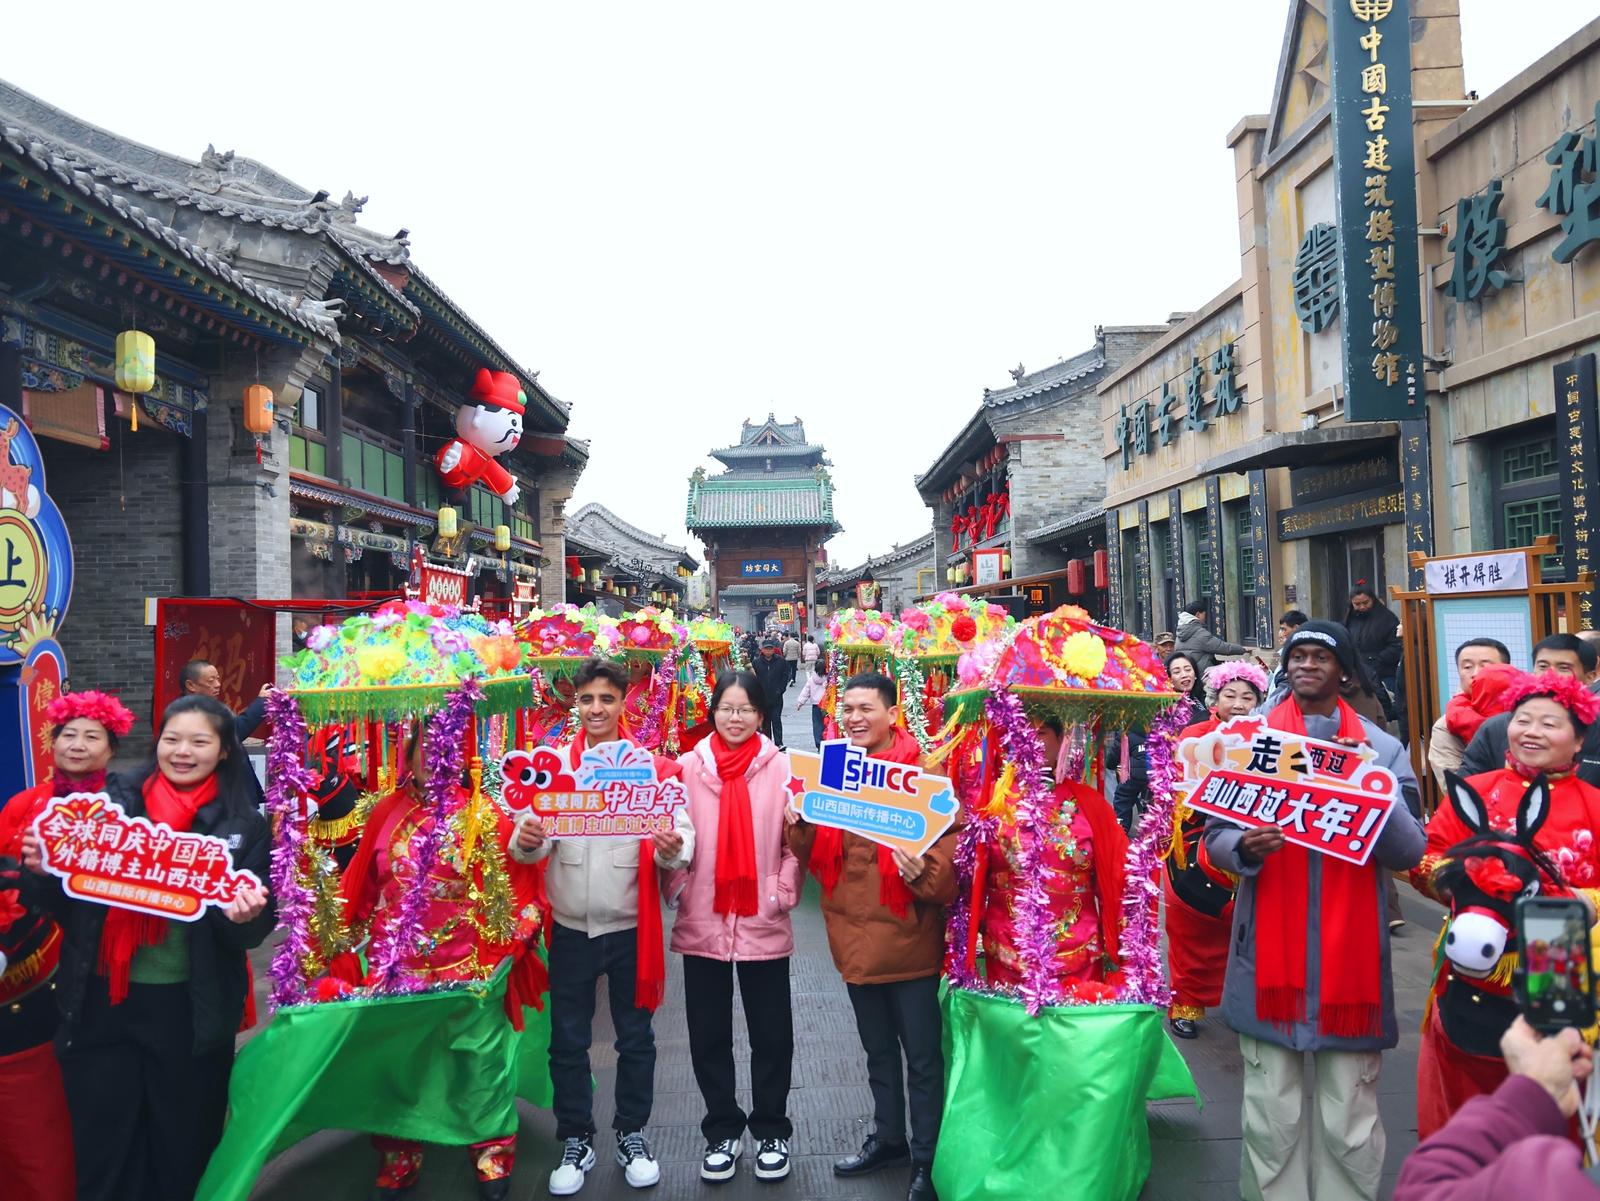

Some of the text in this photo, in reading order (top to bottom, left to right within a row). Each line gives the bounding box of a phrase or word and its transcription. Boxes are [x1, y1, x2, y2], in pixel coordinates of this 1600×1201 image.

[1246, 736, 1282, 774] 走
[845, 759, 919, 794] SHICC
[540, 784, 686, 813] 全球同庆 中国年
[812, 797, 916, 829] 山西国际传播中心
[542, 816, 673, 835] 外籍博主山西过大年
[44, 815, 225, 870] 全球同庆中国年
[83, 878, 186, 909] 山西国际传播中心
